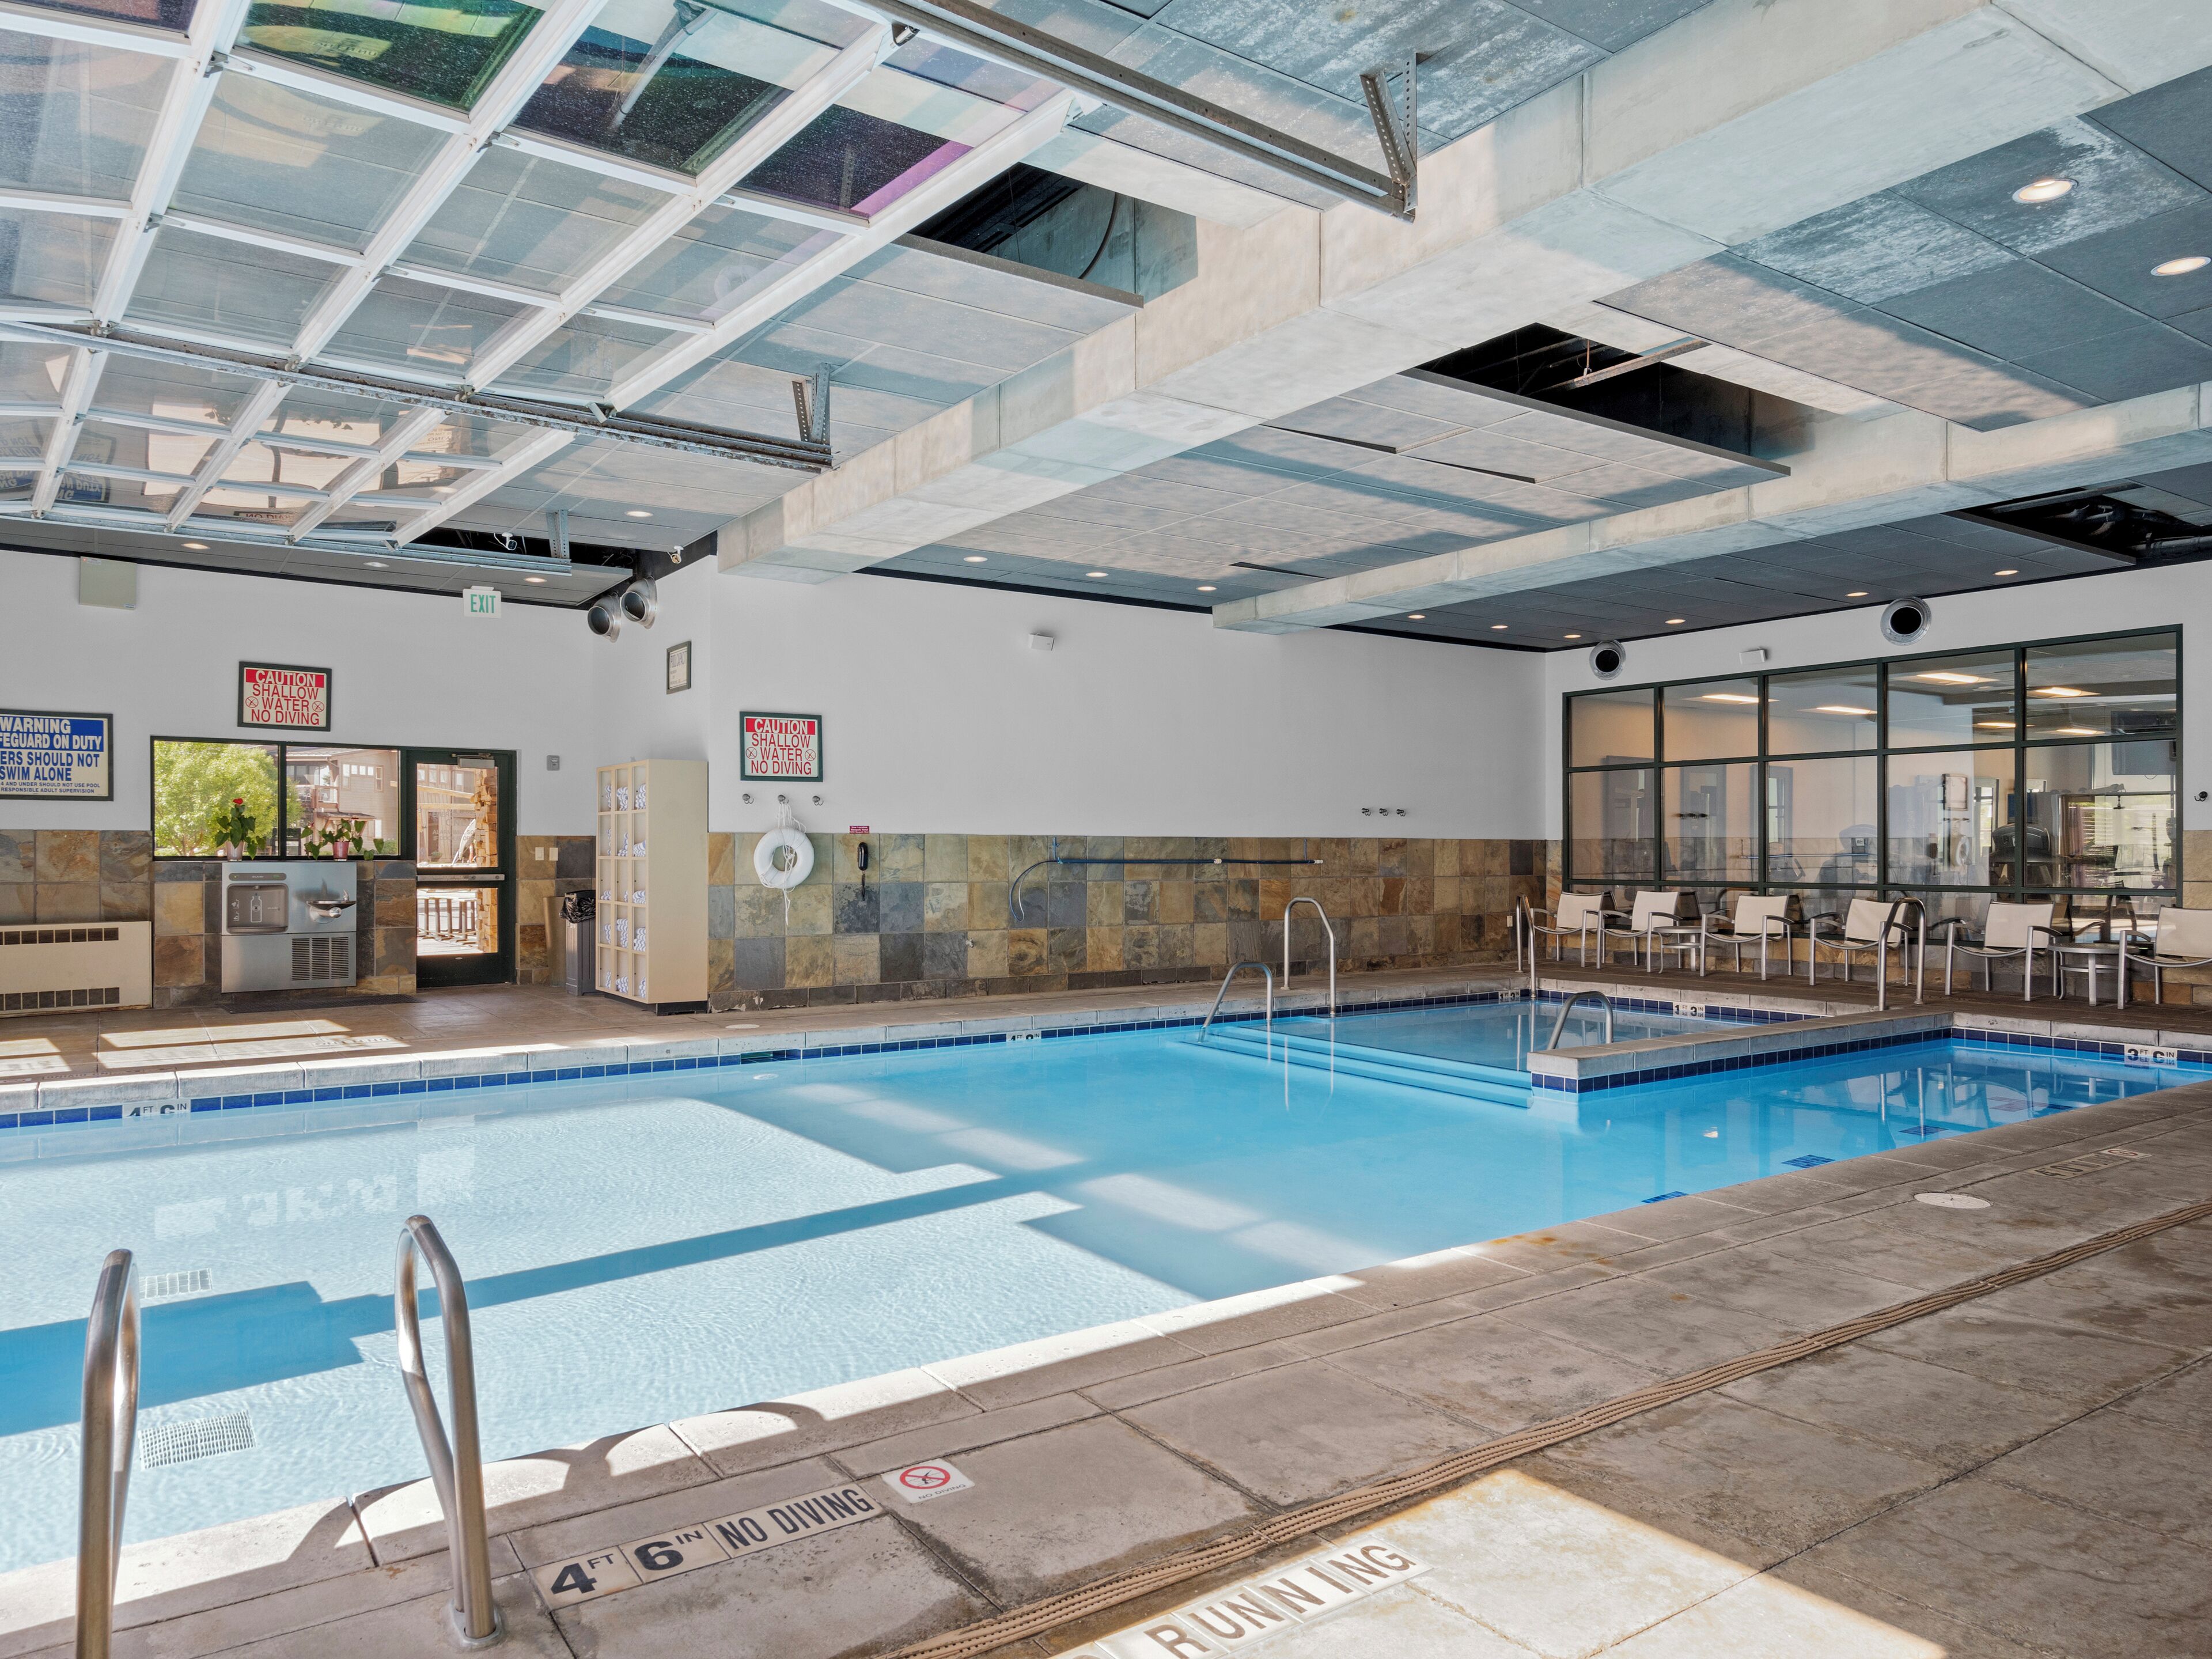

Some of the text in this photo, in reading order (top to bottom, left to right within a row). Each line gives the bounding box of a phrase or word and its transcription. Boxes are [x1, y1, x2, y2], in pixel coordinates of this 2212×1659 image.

[470, 594, 496, 613] EXIT
[256, 670, 316, 687] CAUTION
[252, 683, 319, 700] SHALLOW
[262, 696, 309, 712] WATER
[251, 709, 320, 725] NO DIVING
[0, 717, 71, 734] WARNING
[754, 718, 808, 734] CAUTION
[53, 734, 70, 749] ON
[73, 735, 102, 750] DUTY
[752, 733, 810, 748] SHALLOW
[27, 751, 73, 767] SHOULD
[77, 753, 100, 767] NOT
[760, 747, 802, 761] WATER
[0, 766, 72, 781] SWIM ALONE
[751, 760, 812, 775] NO DIVING
[935, 1483, 966, 1494] DIVING
[551, 1489, 875, 1594] 4 FT 6 IN NO DIVING
[1143, 1544, 1417, 1659] RUNNING
